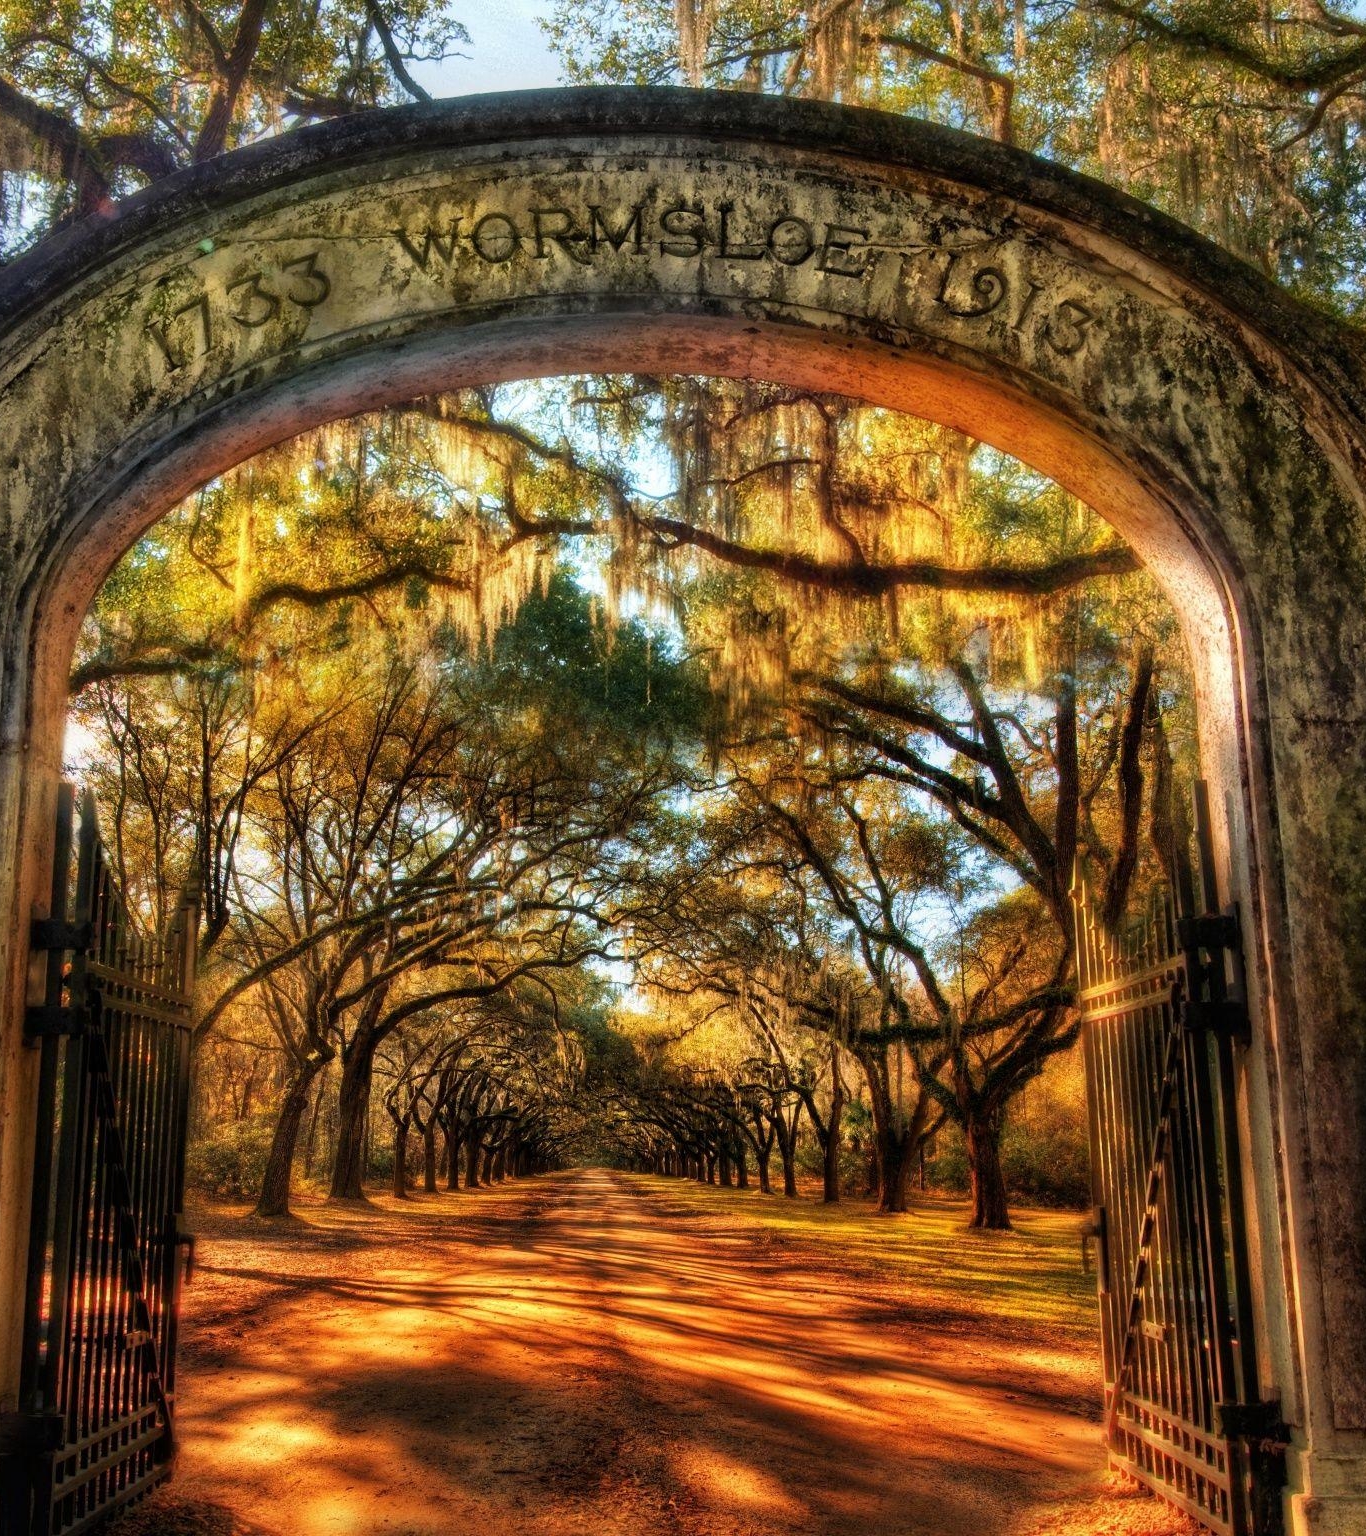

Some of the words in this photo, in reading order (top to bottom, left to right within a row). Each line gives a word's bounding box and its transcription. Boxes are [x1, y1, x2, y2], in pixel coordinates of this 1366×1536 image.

[144, 252, 332, 373] 1733
[392, 204, 870, 278] WORMSLOE
[932, 250, 1099, 356] 1913
